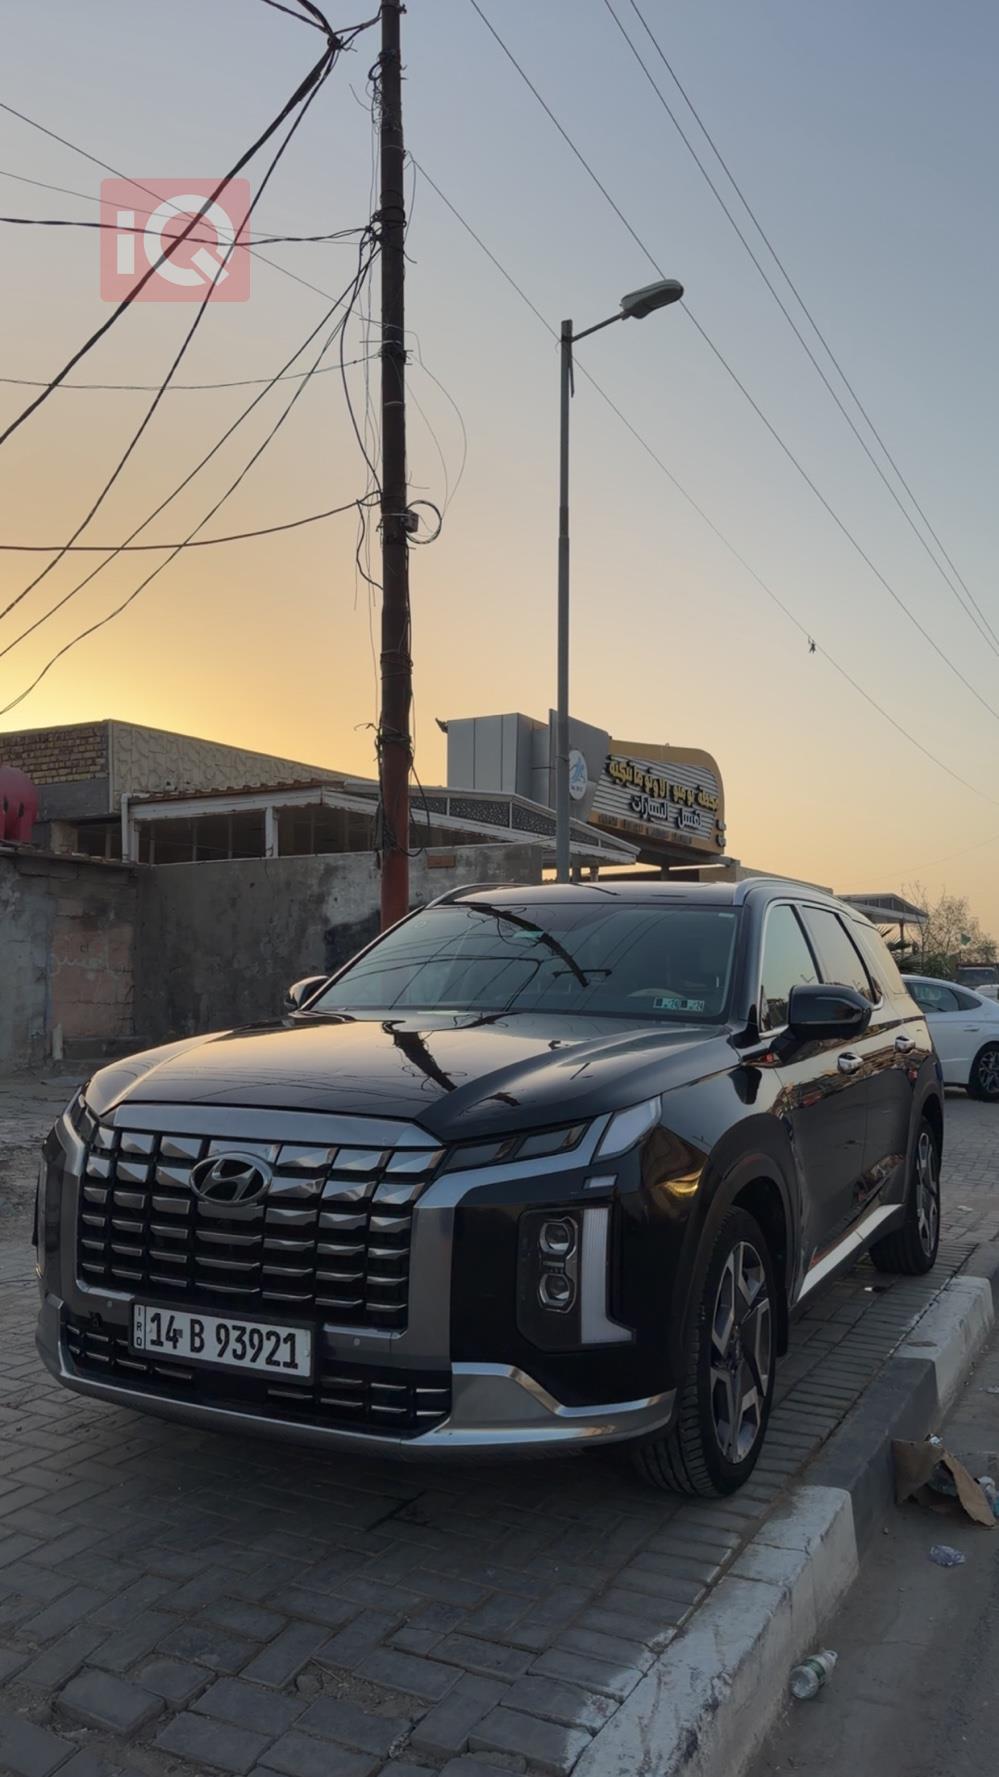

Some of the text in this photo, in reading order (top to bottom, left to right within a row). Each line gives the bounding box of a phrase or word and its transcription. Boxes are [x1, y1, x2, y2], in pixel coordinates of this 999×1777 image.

[631, 795, 668, 820] السيارات
[150, 1312, 298, 1370] 14 B 93921
